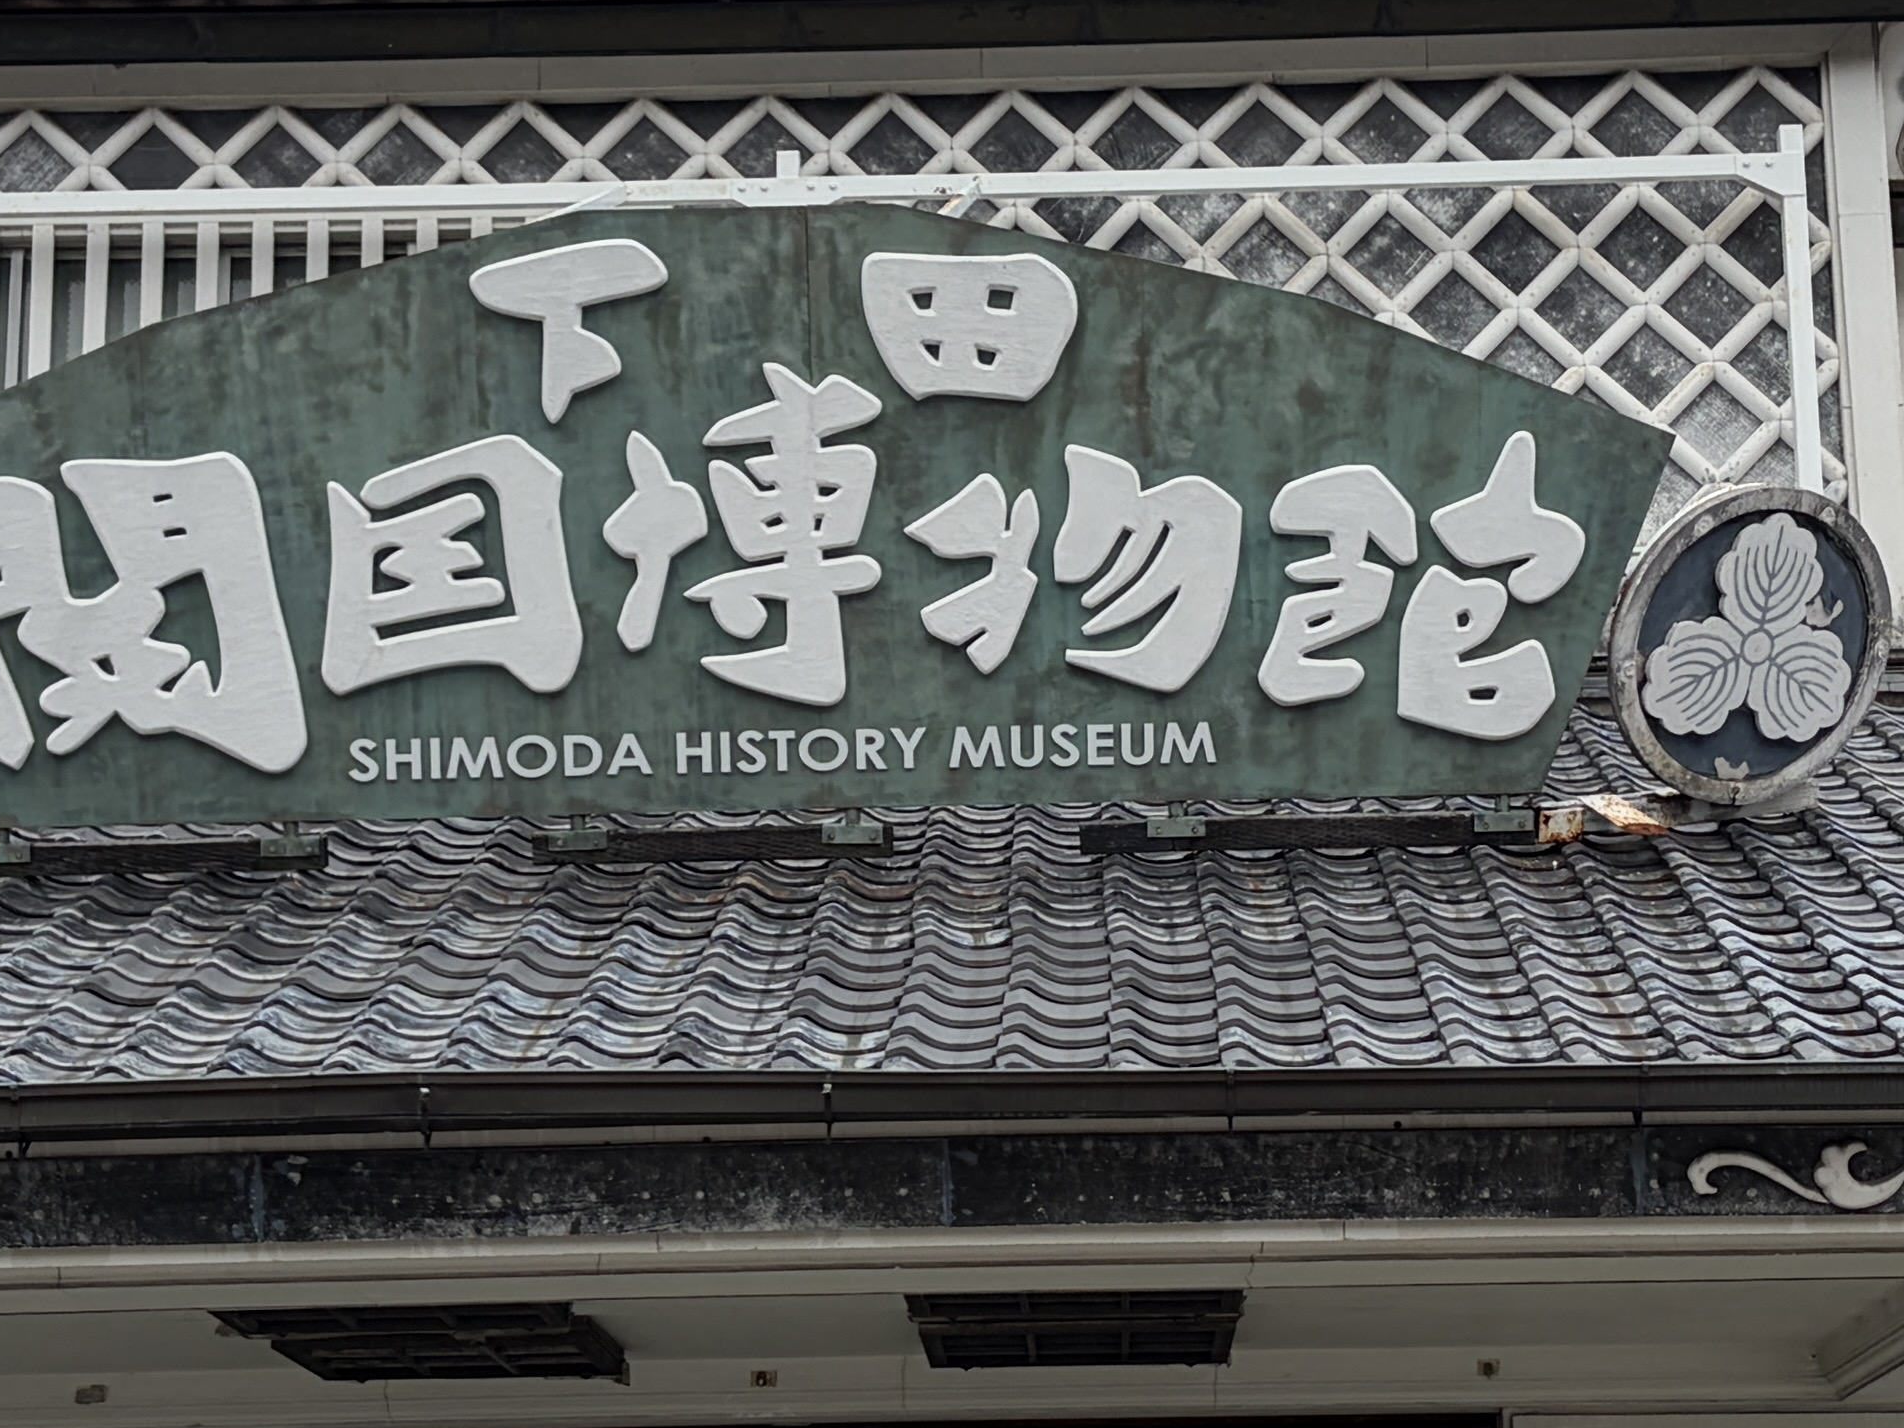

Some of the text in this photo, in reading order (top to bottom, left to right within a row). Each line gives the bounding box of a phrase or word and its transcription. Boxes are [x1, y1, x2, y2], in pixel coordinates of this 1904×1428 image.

[469, 236, 1079, 423] 下田
[348, 721, 1217, 782] SHIMODA HISTORY MUSEUM
